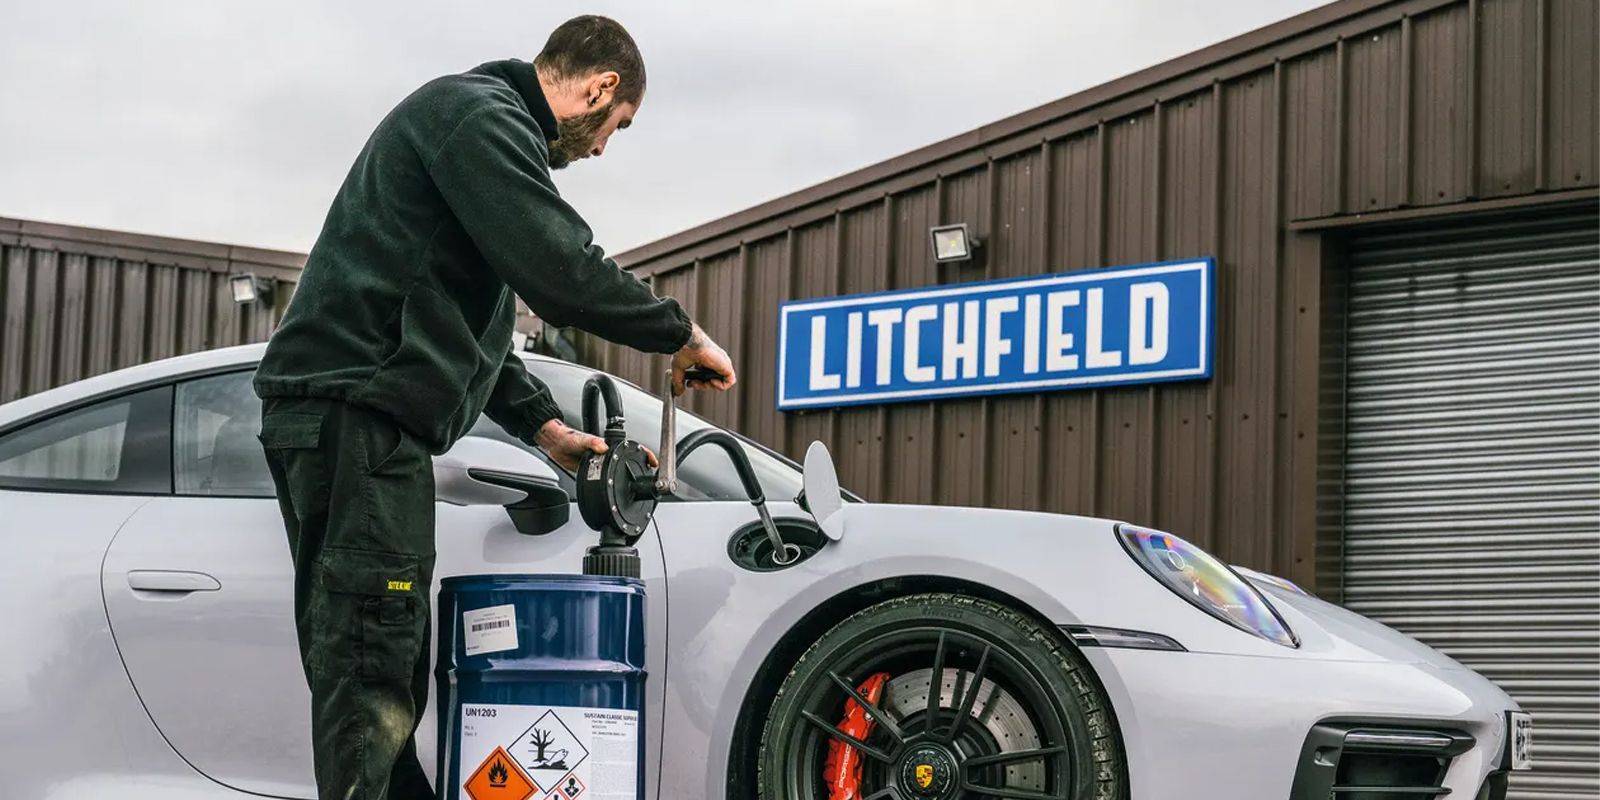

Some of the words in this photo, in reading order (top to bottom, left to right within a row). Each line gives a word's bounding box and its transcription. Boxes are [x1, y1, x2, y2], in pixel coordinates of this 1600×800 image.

[808, 281, 1170, 391] LITCHFIELD
[465, 707, 497, 718] UN1203
[838, 741, 852, 789] PORSC
